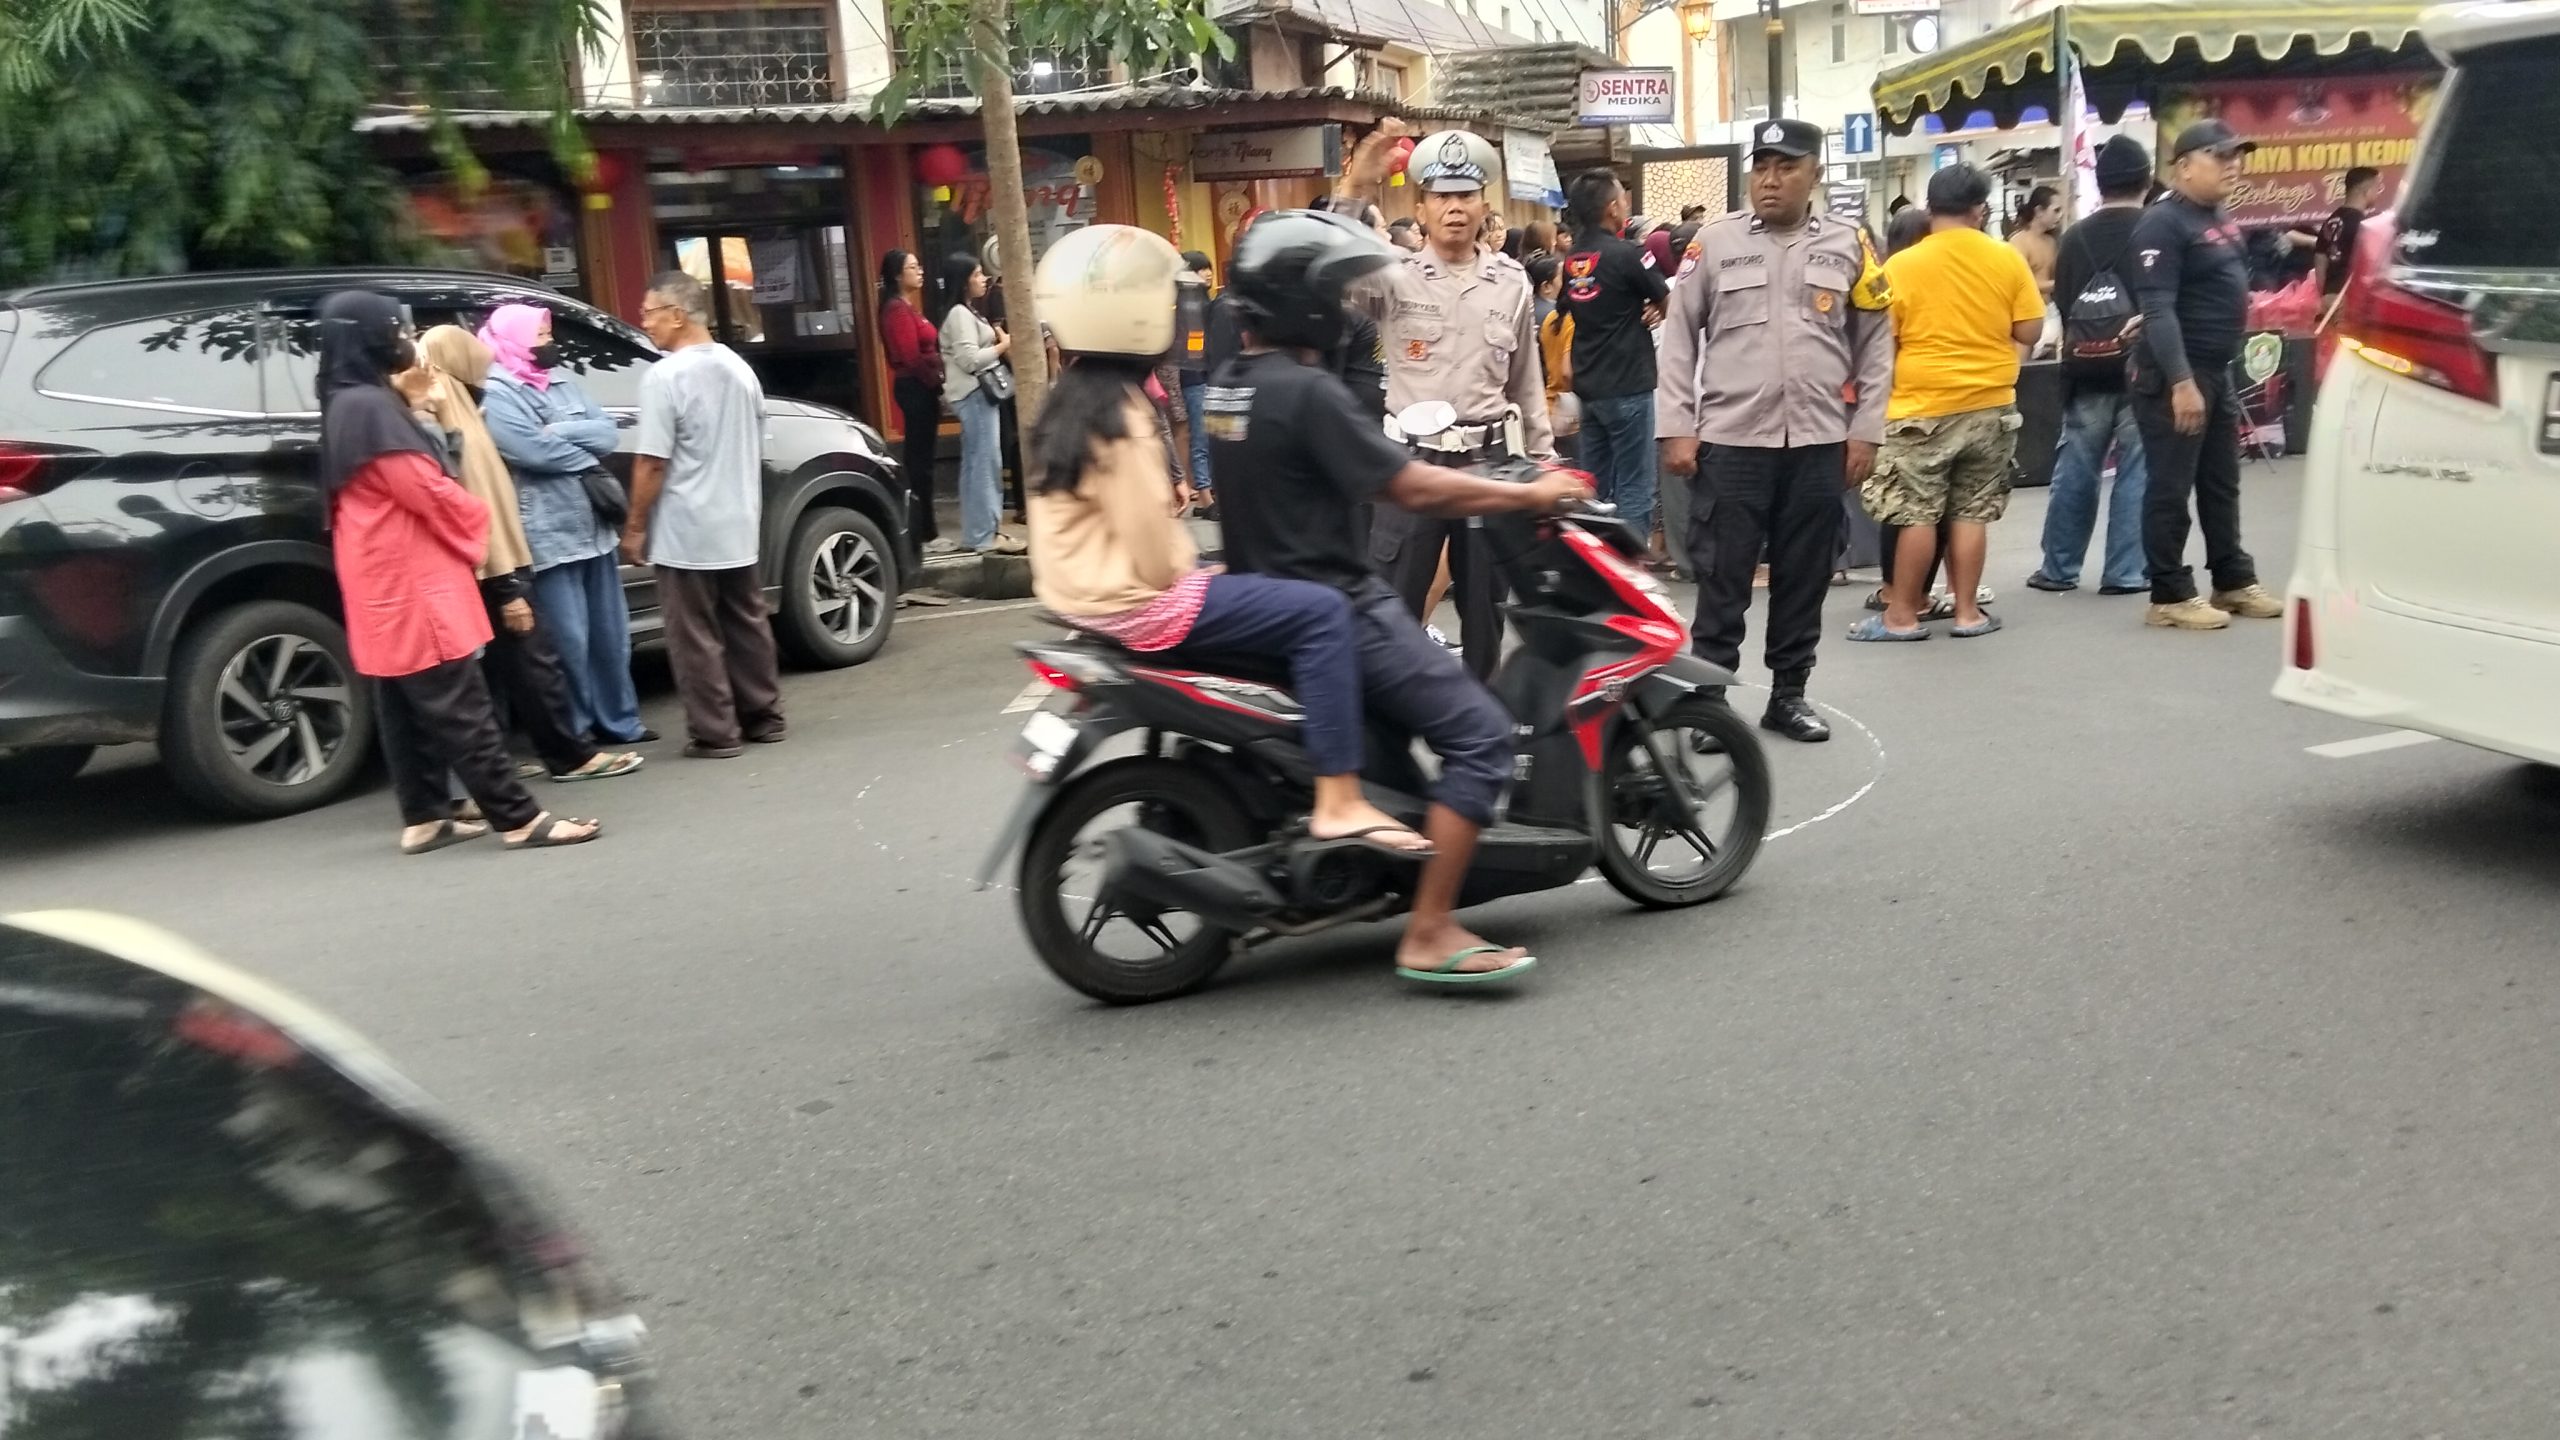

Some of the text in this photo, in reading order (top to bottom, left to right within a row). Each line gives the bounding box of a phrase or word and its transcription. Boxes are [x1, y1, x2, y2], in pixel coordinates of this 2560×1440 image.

[1601, 79, 1669, 96] SENTRA
[1608, 96, 1661, 105] MEDIKA
[2296, 141, 2351, 172] KOTA
